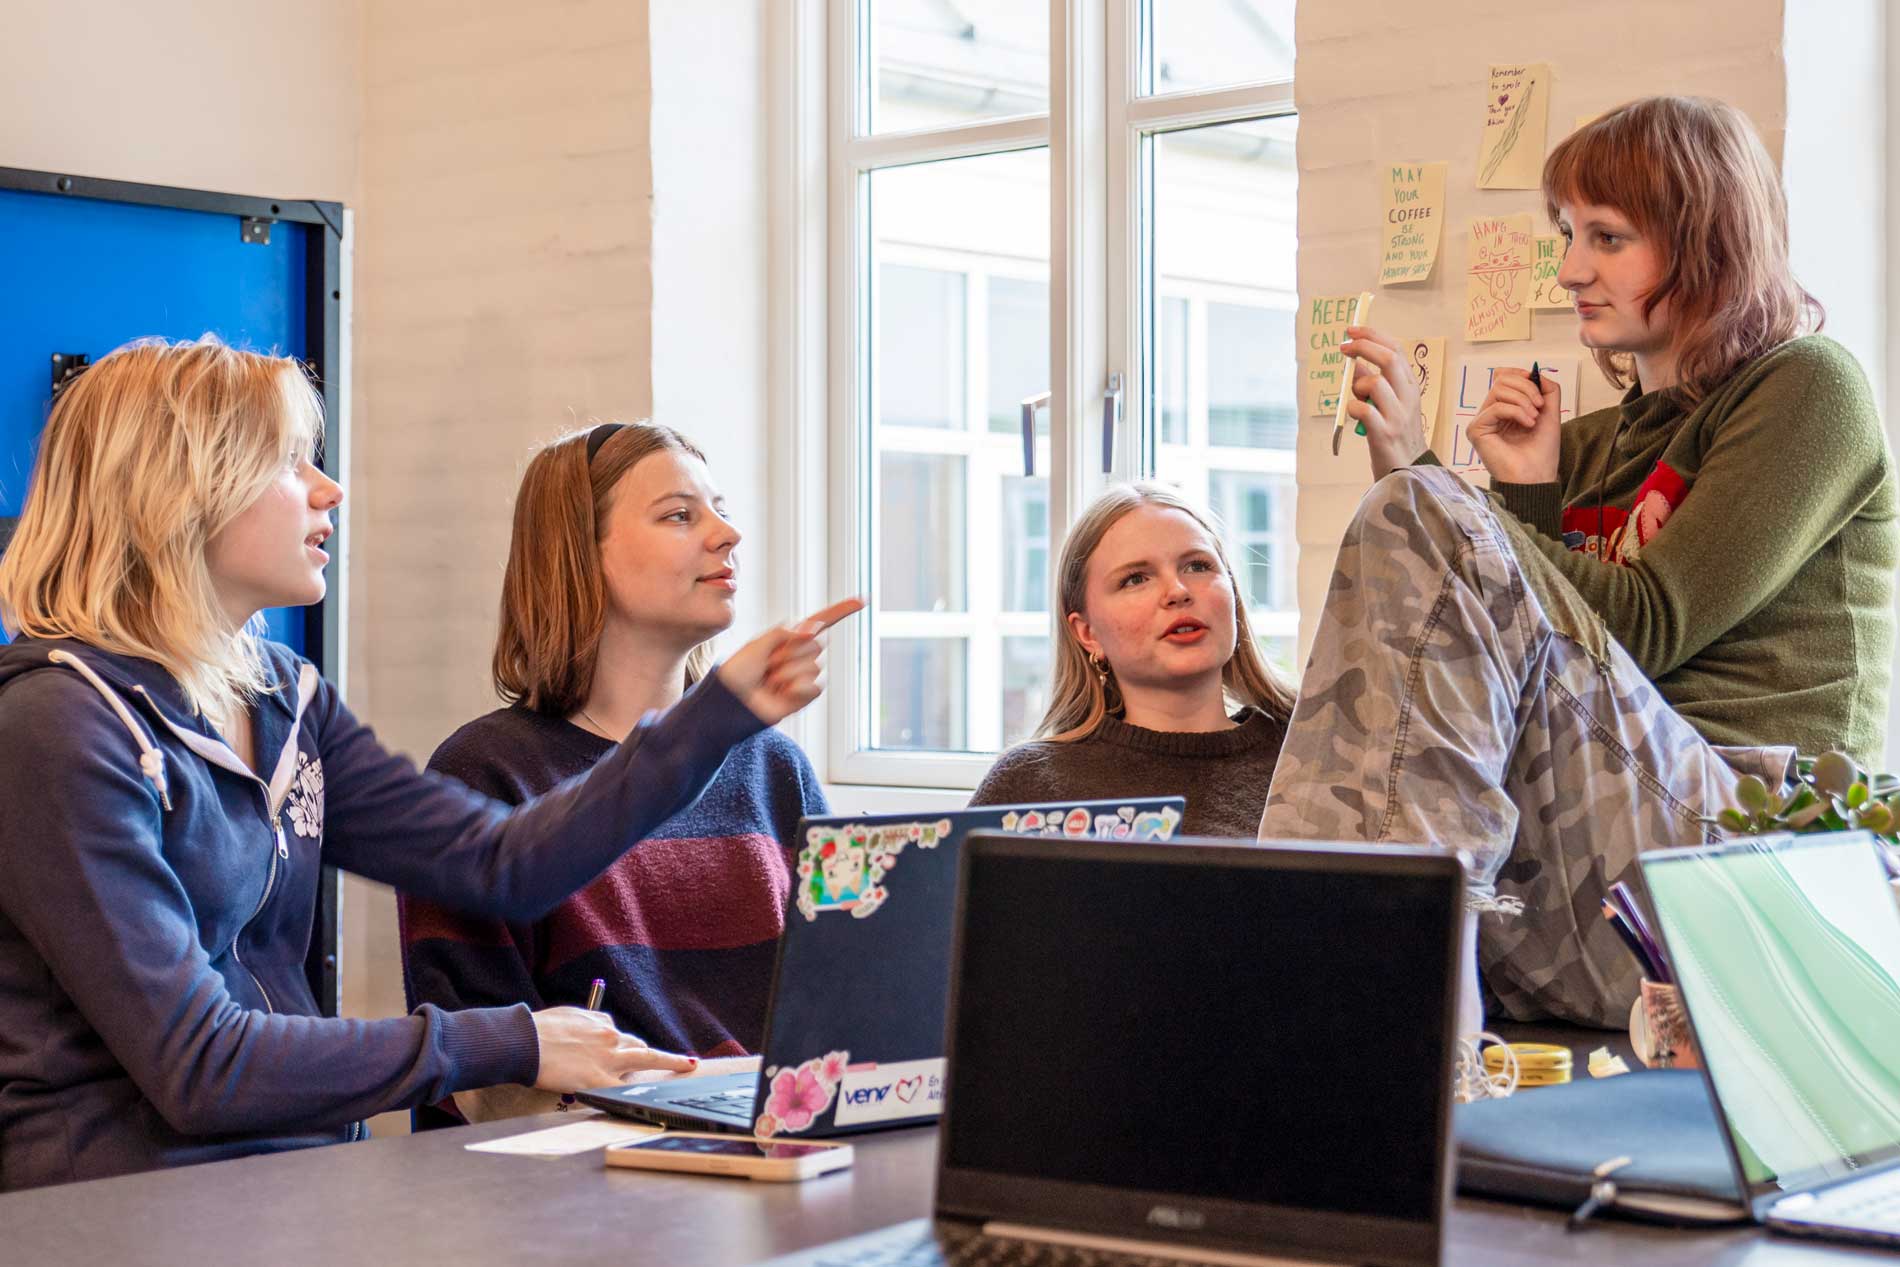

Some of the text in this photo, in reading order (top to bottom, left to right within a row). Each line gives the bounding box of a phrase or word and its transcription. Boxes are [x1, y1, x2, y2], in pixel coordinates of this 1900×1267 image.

[1492, 80, 1521, 91] to smile
[1392, 168, 1423, 183] MAY
[1394, 188, 1419, 204] YOUR
[1388, 207, 1432, 224] COFFEE
[1401, 224, 1414, 234] BE
[1473, 221, 1506, 240] HANG
[1392, 233, 1424, 249] STRONG
[1494, 234, 1503, 248] IN
[1385, 249, 1428, 263] AND YOUR
[1535, 239, 1557, 260] THE
[1311, 297, 1358, 325] KEEP
[1321, 352, 1343, 366] AND
